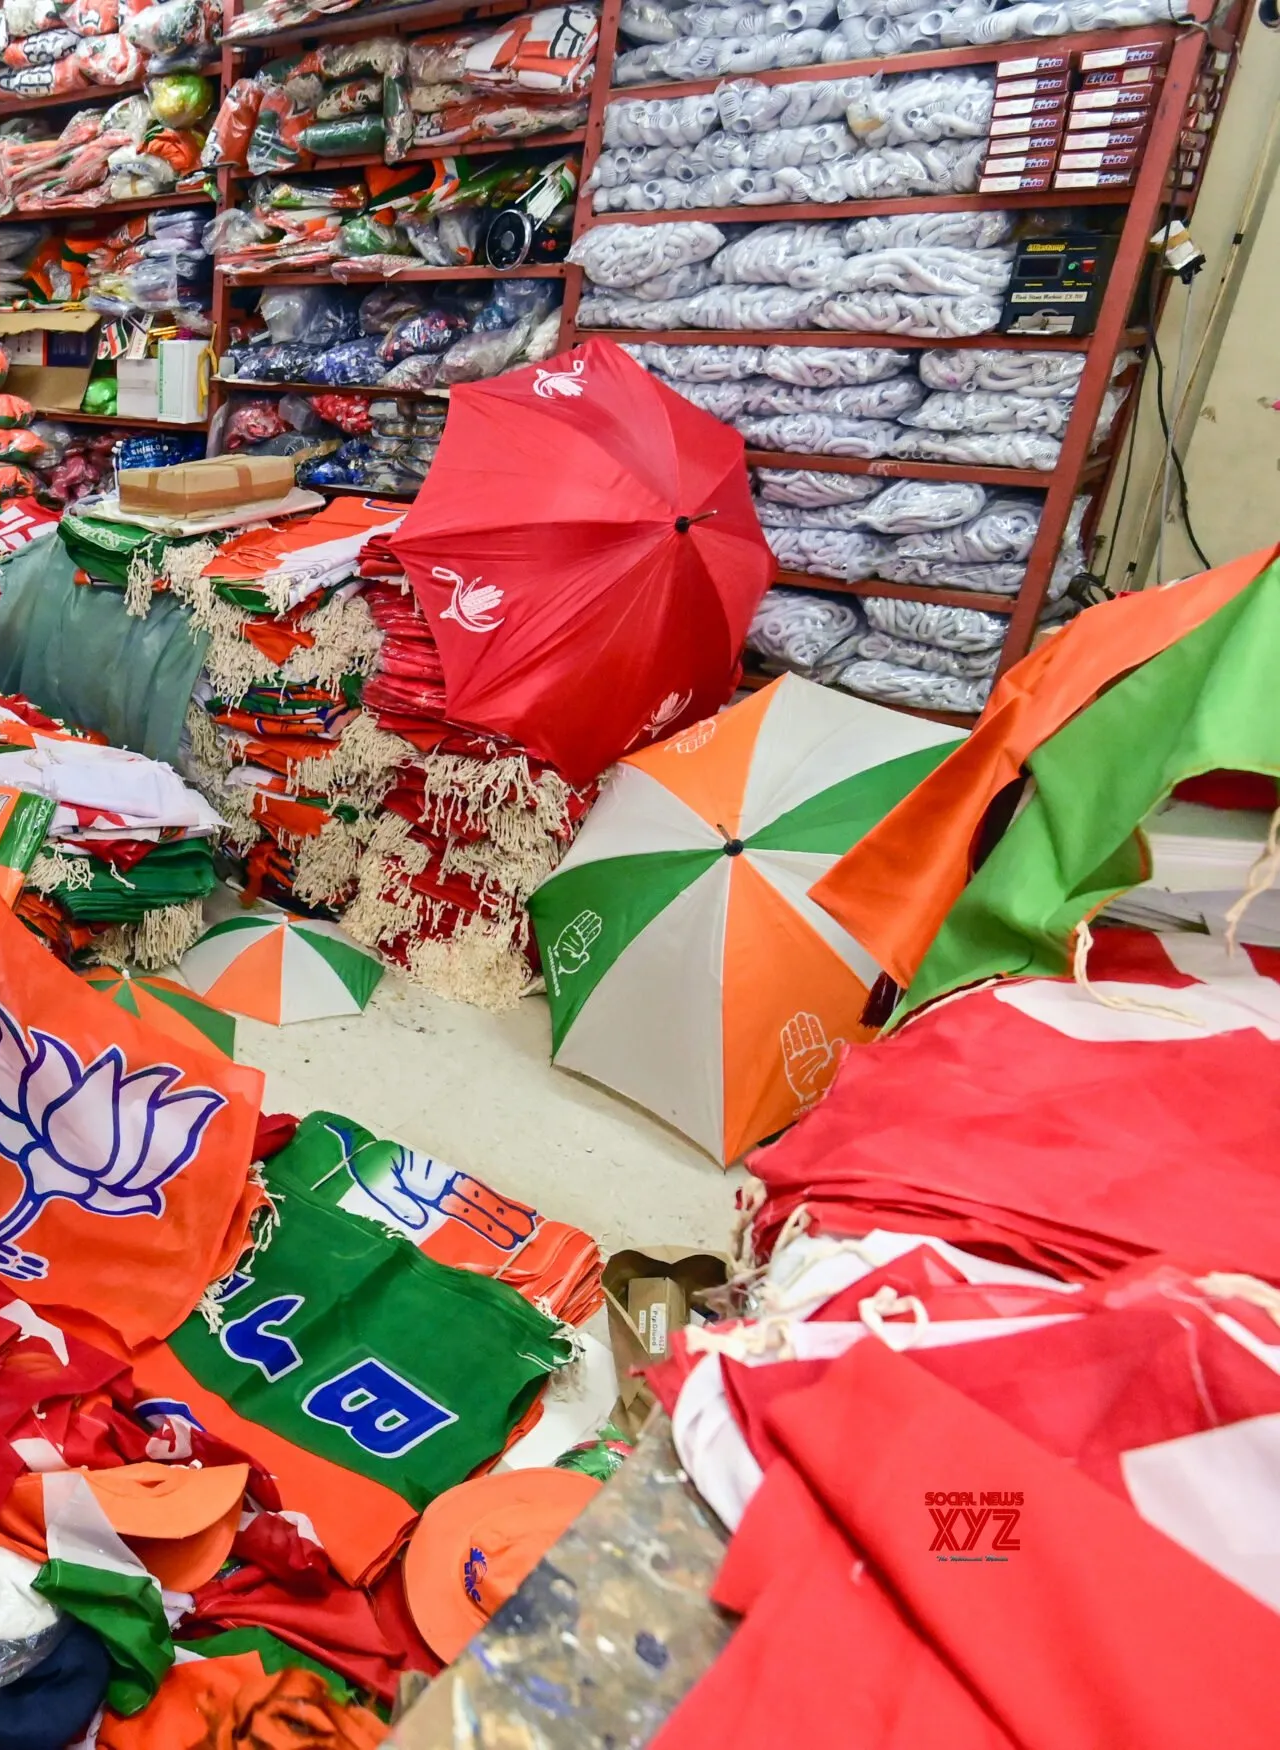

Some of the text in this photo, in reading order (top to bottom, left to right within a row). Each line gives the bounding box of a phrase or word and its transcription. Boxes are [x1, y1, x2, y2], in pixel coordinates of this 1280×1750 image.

[1126, 51, 1153, 61] Ekta
[1038, 57, 1063, 68] Ekta
[1085, 72, 1116, 84] Ekta
[1036, 79, 1061, 89] Ekta
[1117, 92, 1143, 103] Ekta
[1034, 99, 1059, 110] Ekta
[1032, 119, 1056, 128] Ekta
[1030, 138, 1055, 147] Ekta
[1108, 134, 1134, 144] Ekta
[1025, 158, 1049, 168] Ekta
[1102, 154, 1128, 164] Ekta
[1020, 176, 1043, 187] Ekta
